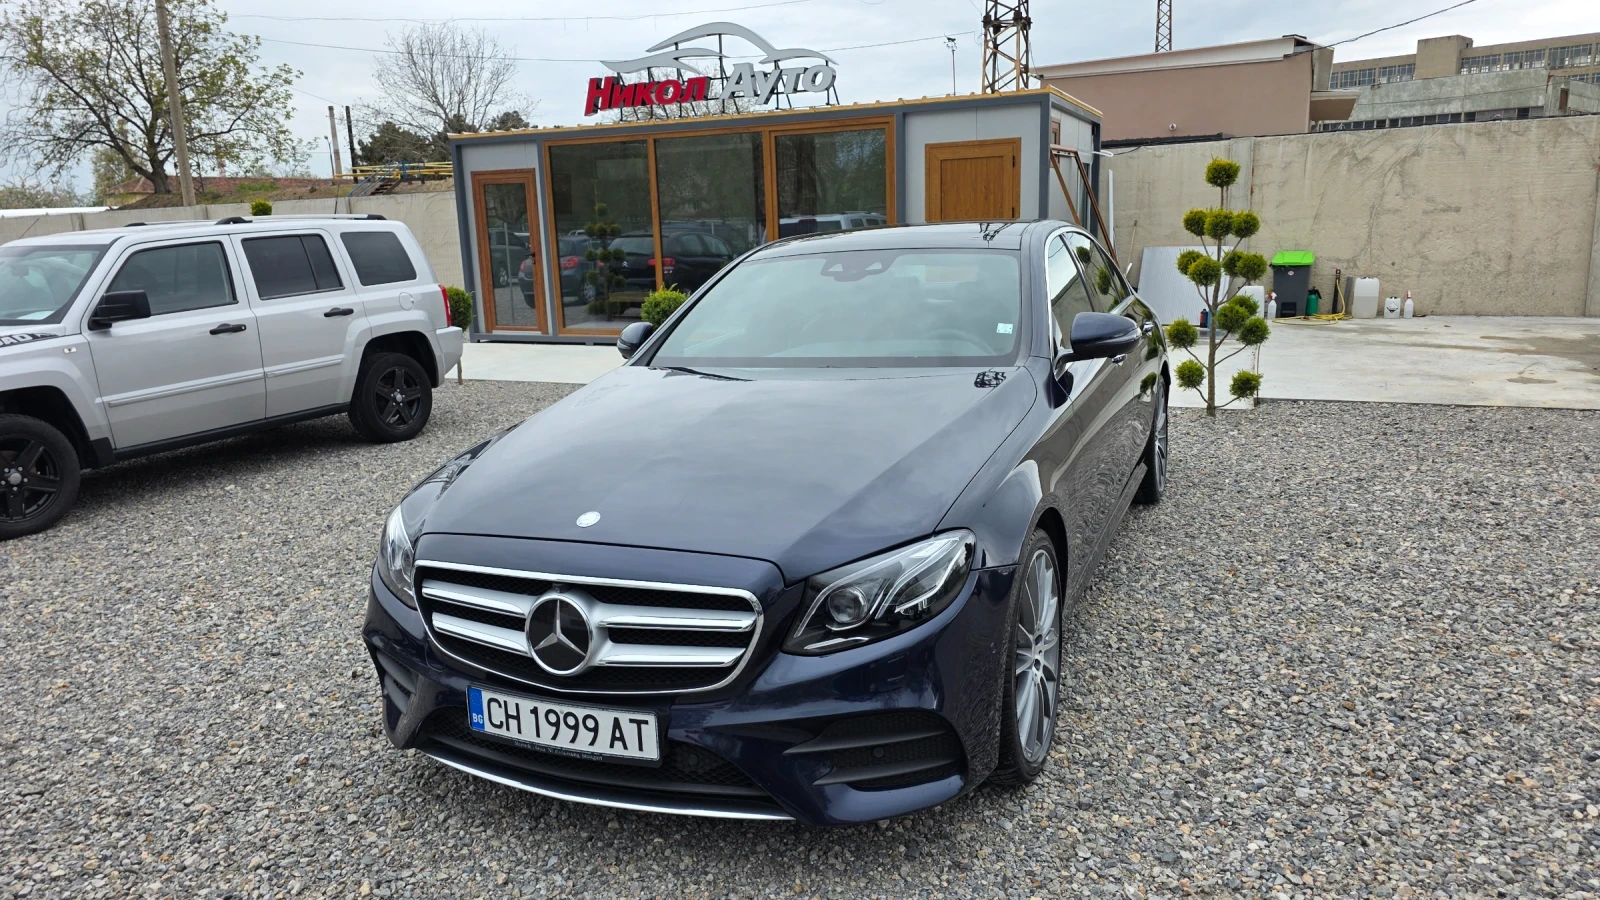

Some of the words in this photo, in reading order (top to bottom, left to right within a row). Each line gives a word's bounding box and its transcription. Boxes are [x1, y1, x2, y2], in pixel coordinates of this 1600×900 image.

[584, 75, 711, 117] Никол
[719, 62, 837, 105] Ауто
[472, 712, 484, 724] BG
[487, 697, 523, 735] CH
[529, 706, 599, 746] 1999
[609, 716, 649, 752] AT
